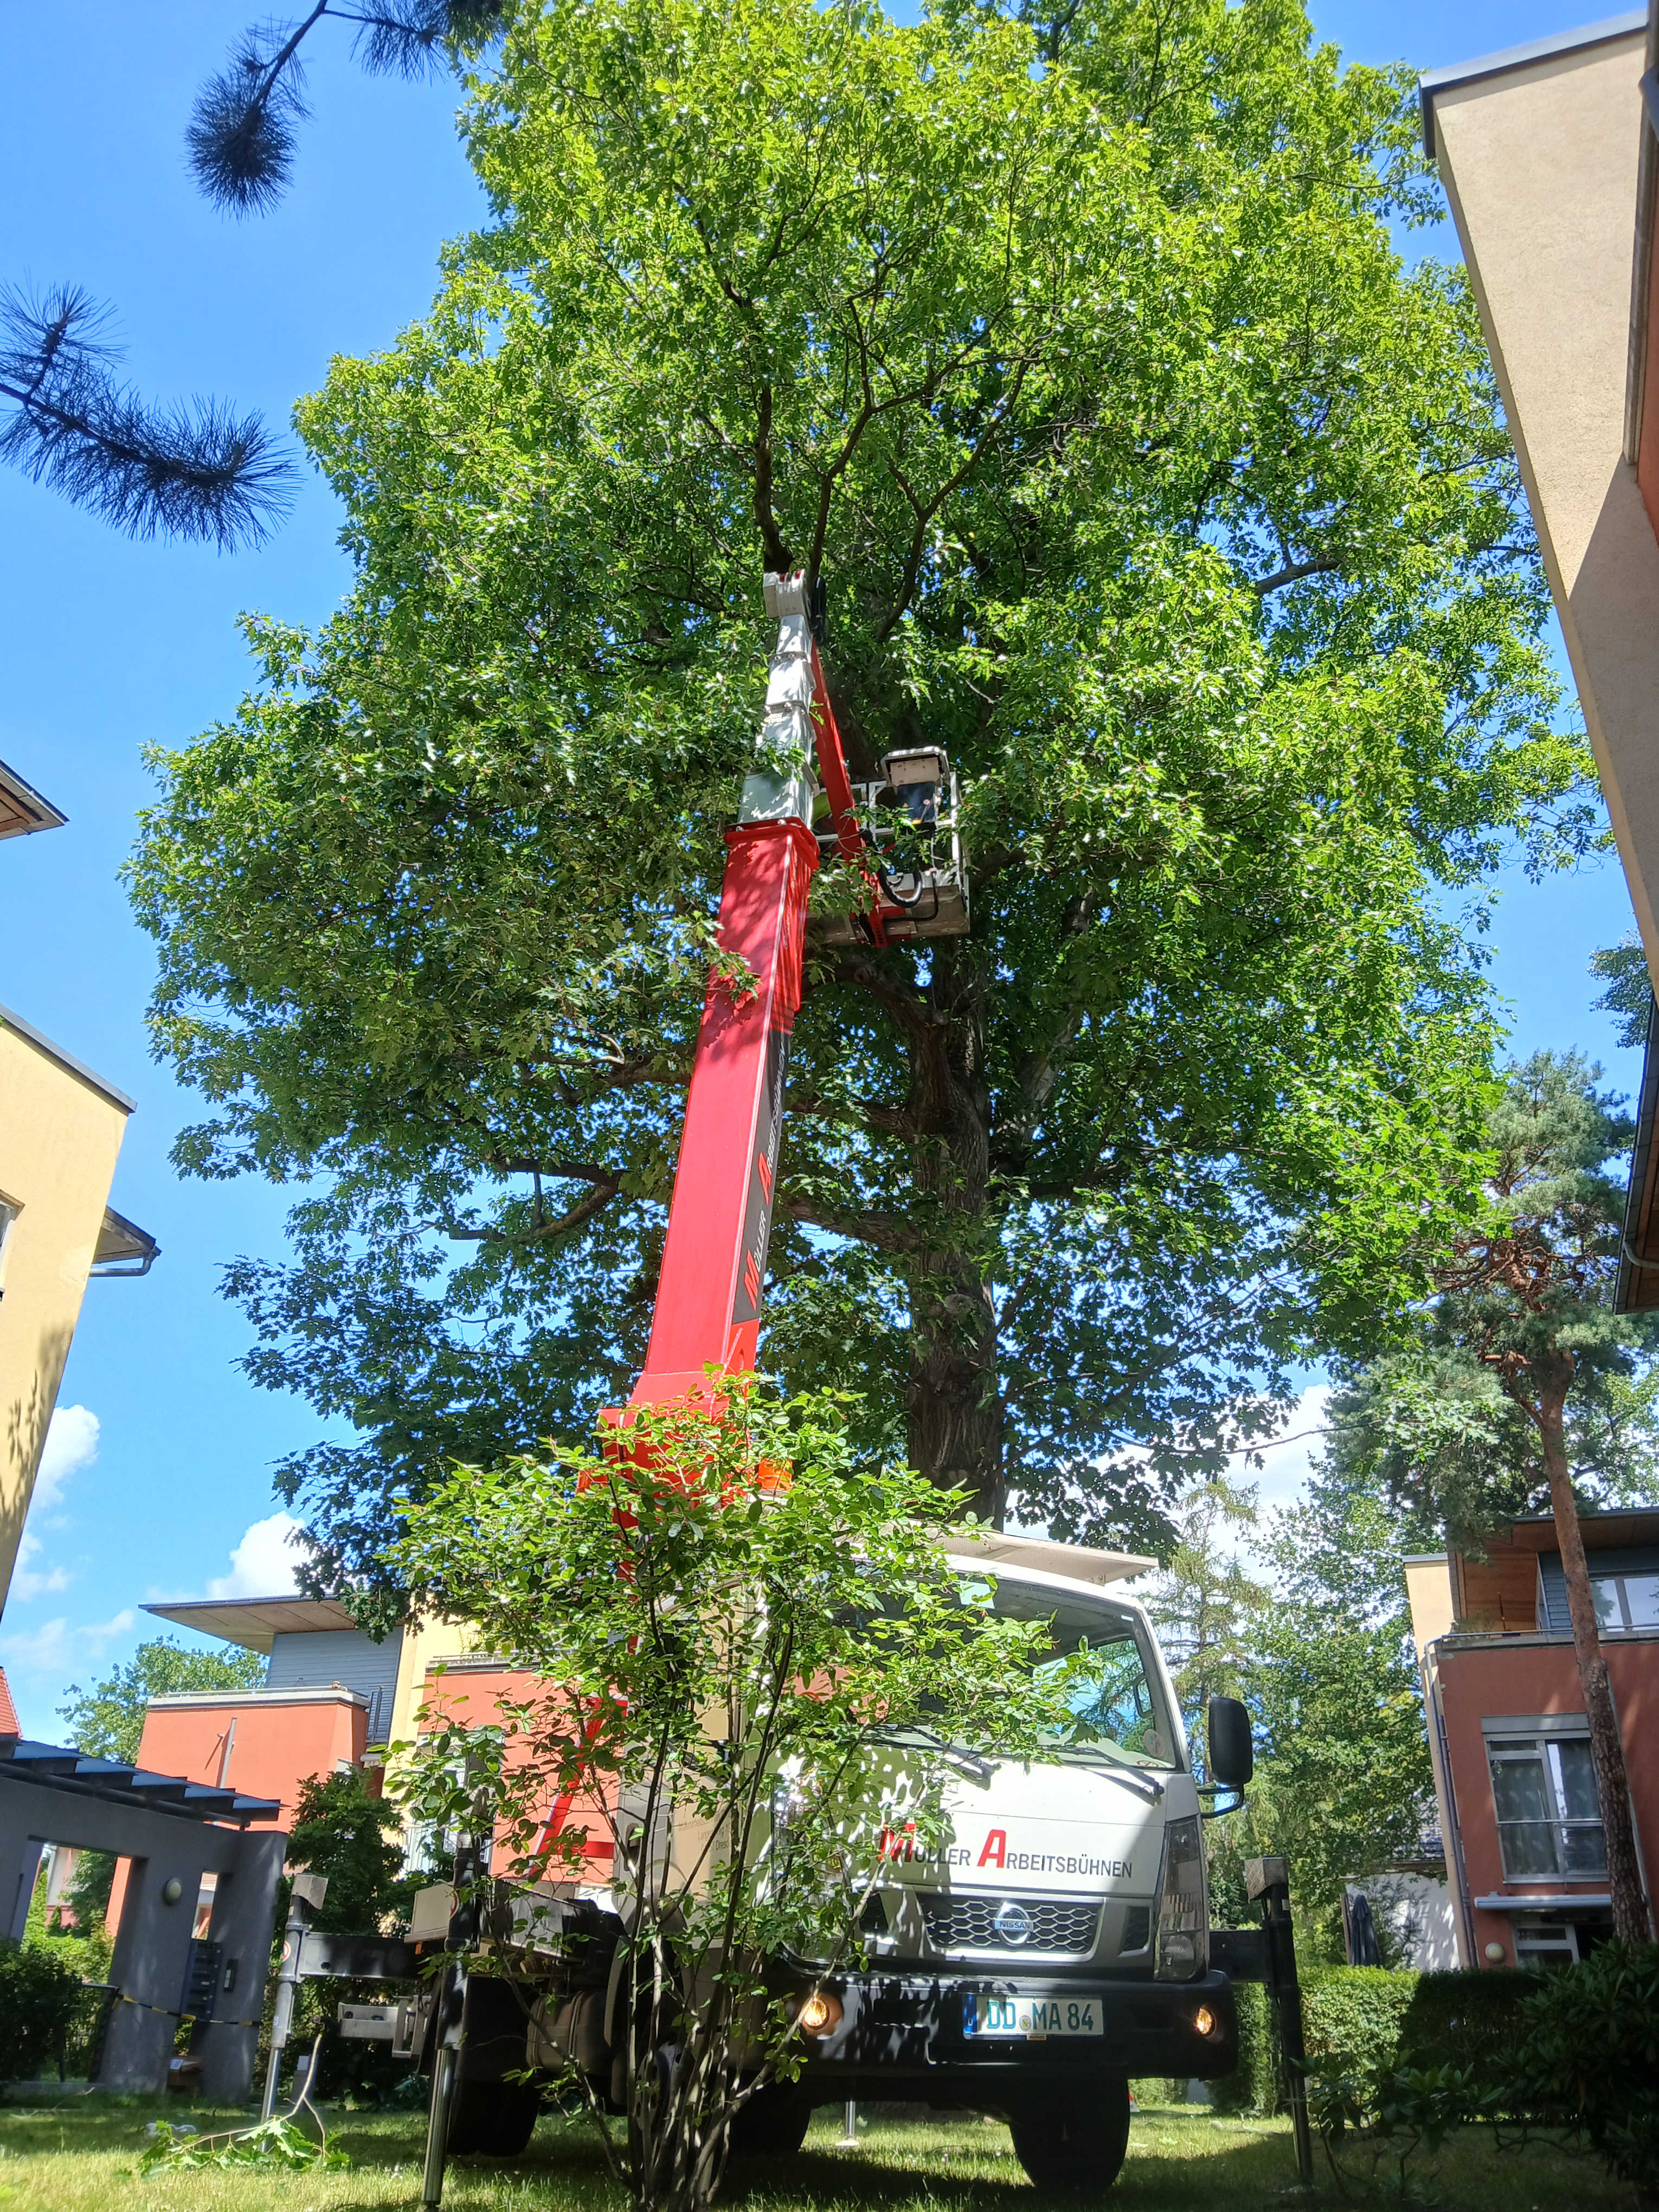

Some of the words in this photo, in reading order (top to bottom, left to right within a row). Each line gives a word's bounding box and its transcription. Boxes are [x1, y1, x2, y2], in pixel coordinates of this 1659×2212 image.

[976, 1829, 1132, 1878] ARBEITSBÜHNEN
[999, 1921, 1030, 1929] NISSAN
[986, 2001, 1016, 2029] DD
[1032, 2002, 1062, 2030] MA
[1068, 2003, 1094, 2030] 84
